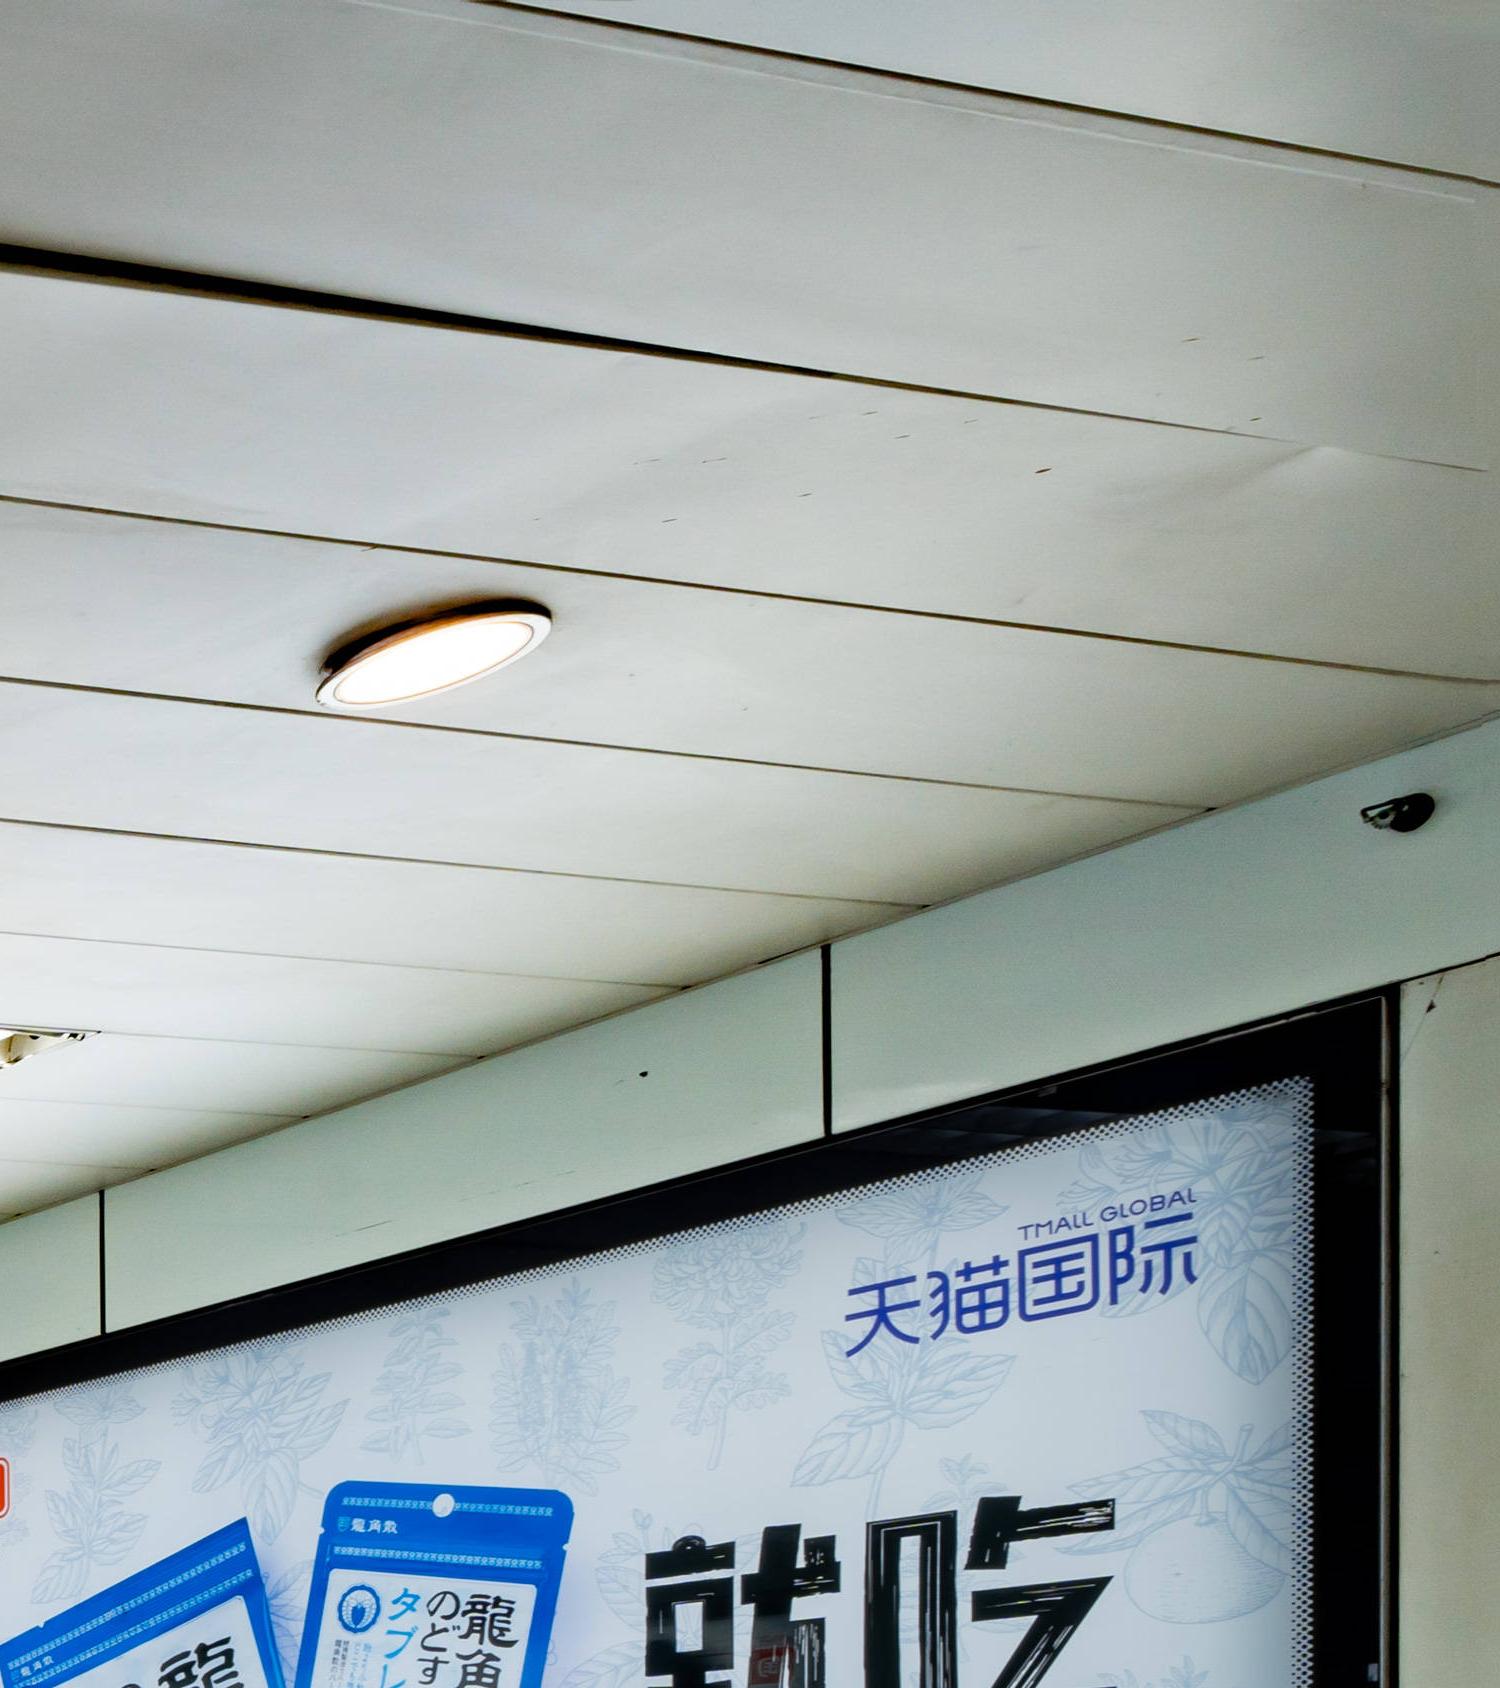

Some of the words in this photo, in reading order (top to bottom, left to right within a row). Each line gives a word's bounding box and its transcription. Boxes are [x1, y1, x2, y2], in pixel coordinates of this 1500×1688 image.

[1017, 1213, 1094, 1241] TMALL
[1100, 1188, 1198, 1222] GLOBAL
[844, 1212, 1199, 1358] 天猫国际
